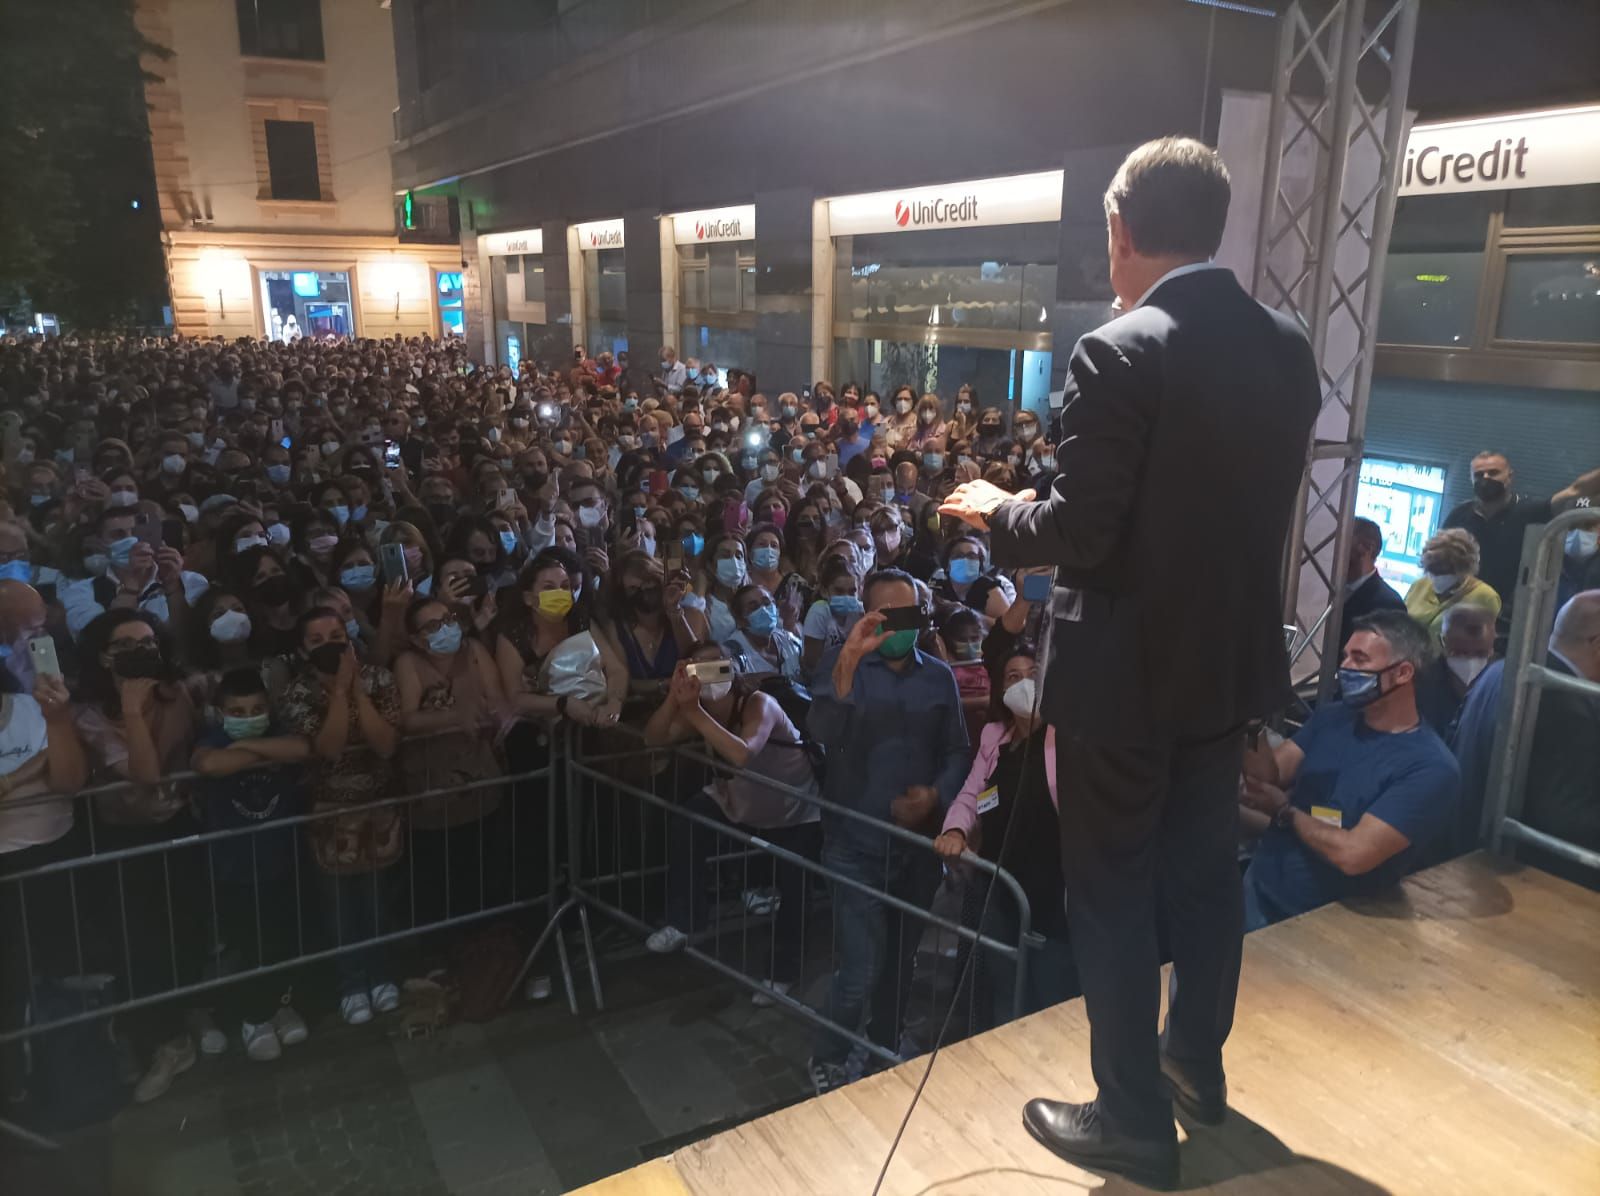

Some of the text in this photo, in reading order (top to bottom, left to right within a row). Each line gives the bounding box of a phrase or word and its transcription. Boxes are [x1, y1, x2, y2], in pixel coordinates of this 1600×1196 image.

[1400, 136, 1529, 187] iCredit
[912, 195, 978, 225] UniCredit
[704, 218, 742, 239] UniCredit
